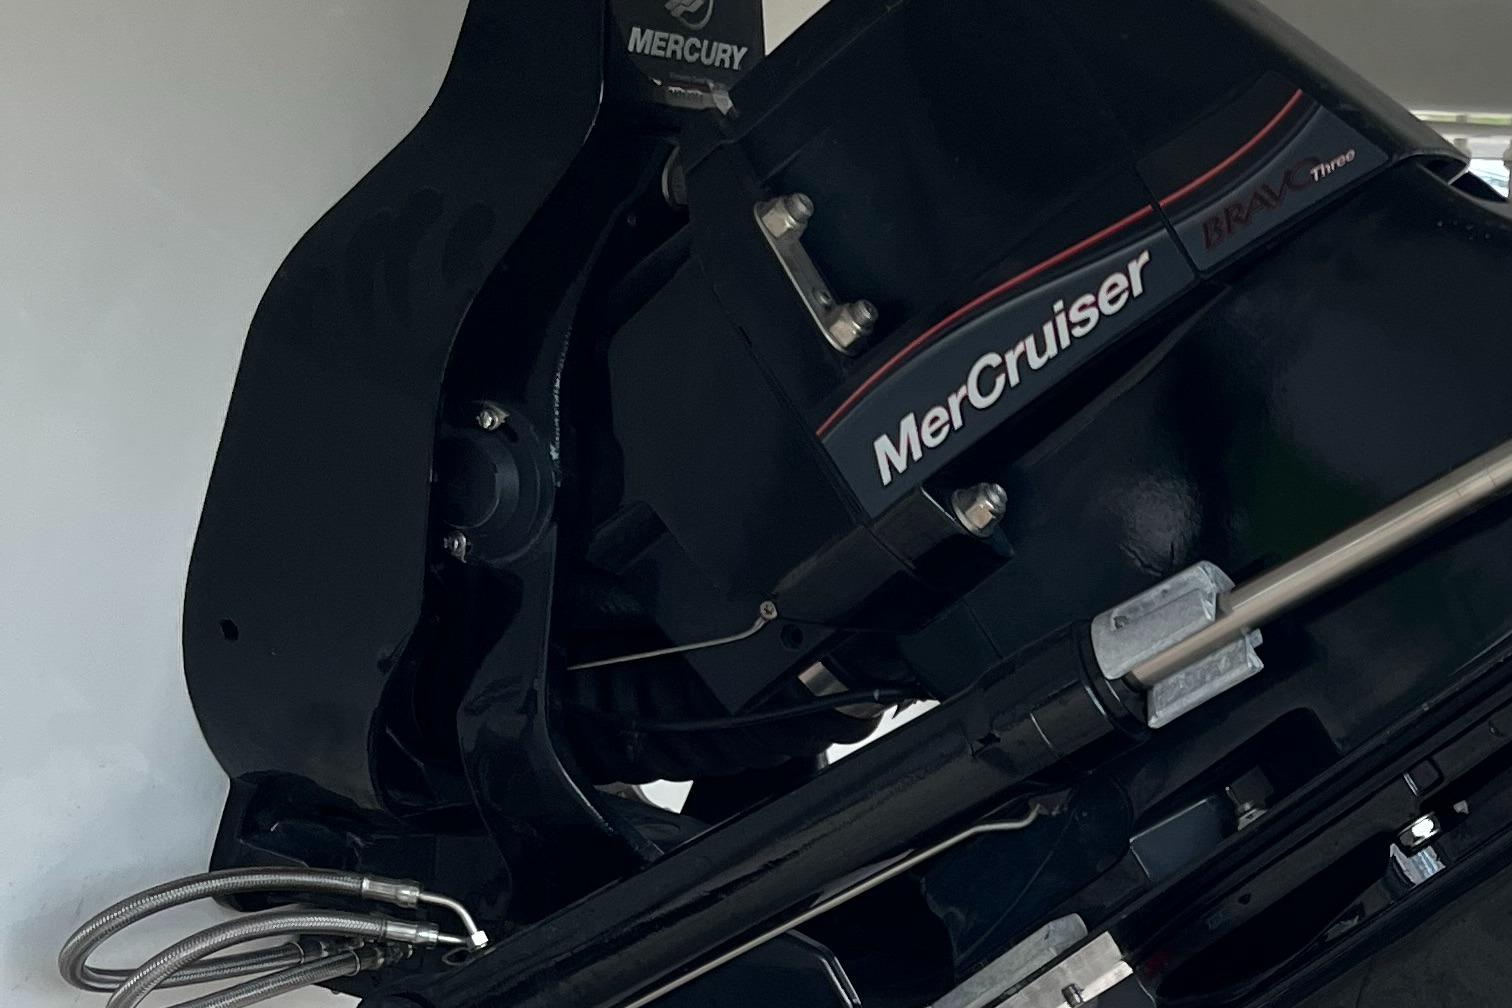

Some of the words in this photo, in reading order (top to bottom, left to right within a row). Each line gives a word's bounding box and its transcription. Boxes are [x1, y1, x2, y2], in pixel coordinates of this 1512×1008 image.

[627, 26, 748, 70] MERCURY
[1309, 148, 1357, 183] Three
[872, 249, 1151, 487] MerCruiser
